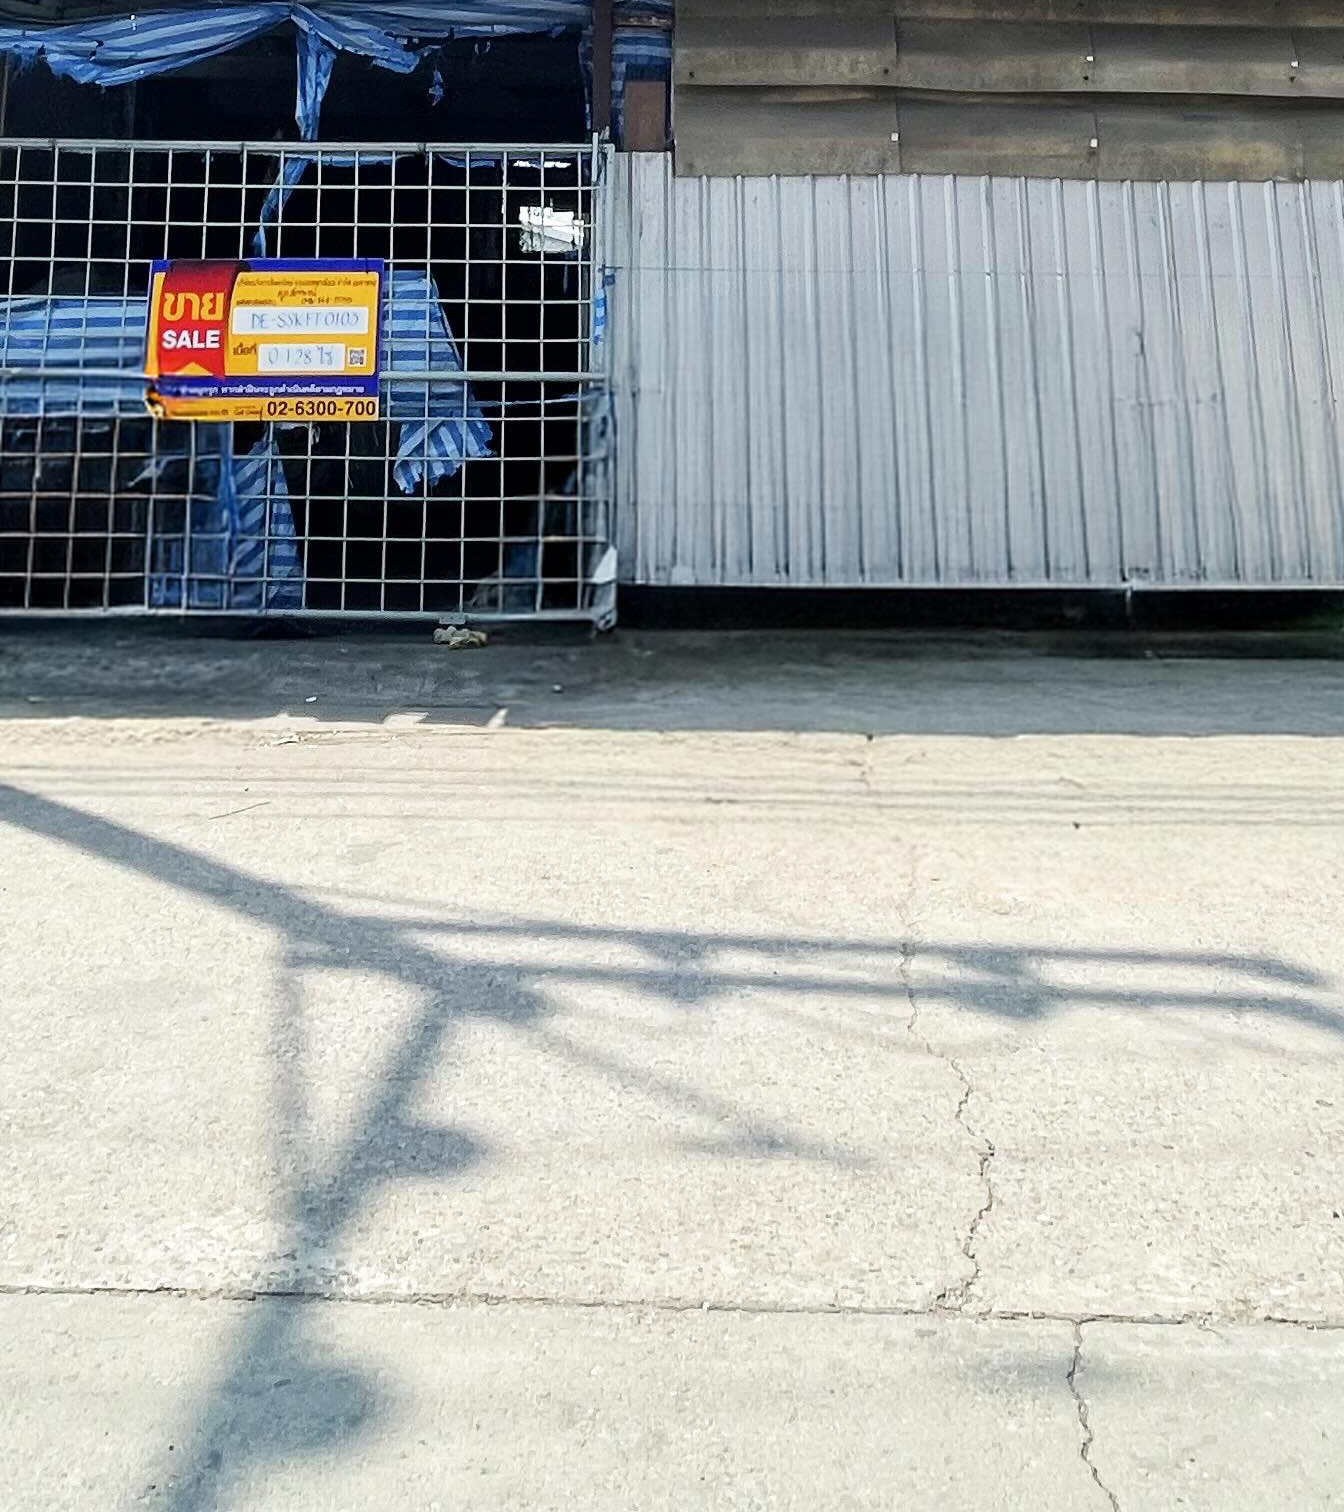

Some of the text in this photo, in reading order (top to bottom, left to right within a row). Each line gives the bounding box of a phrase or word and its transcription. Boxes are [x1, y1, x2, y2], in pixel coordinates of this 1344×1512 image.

[163, 292, 225, 321] ขาย
[162, 329, 221, 350] SALE
[267, 400, 377, 417] 02-6300-700
